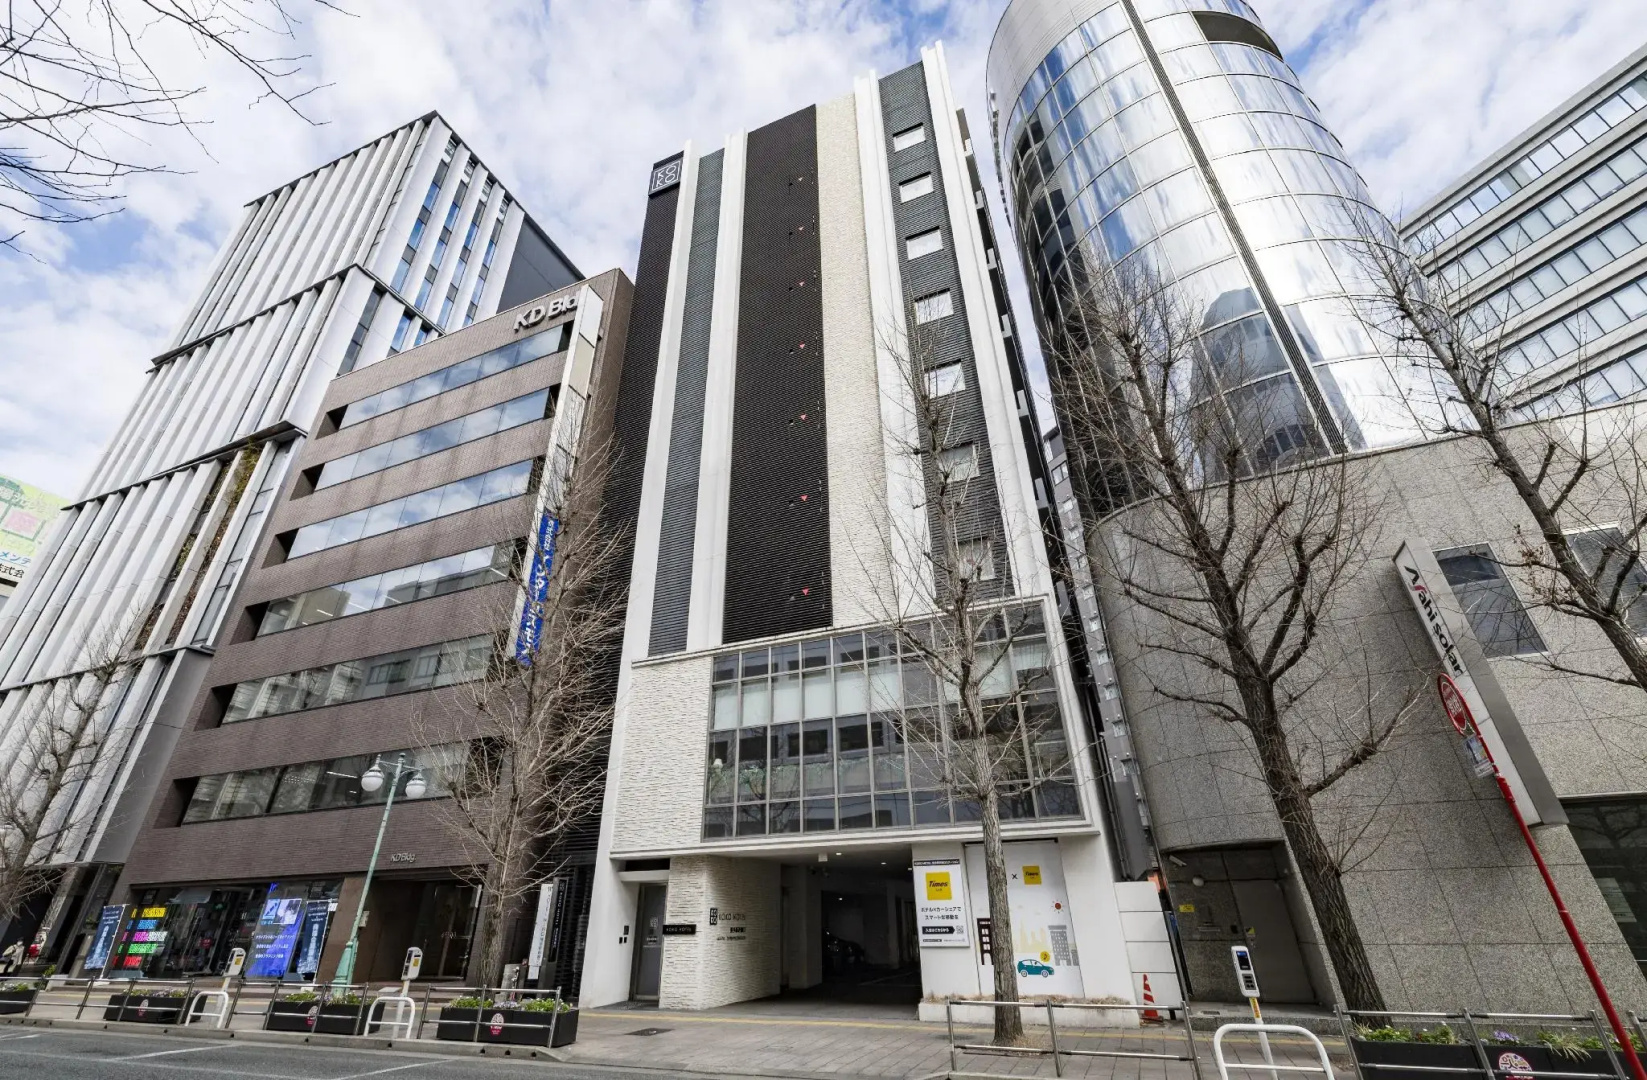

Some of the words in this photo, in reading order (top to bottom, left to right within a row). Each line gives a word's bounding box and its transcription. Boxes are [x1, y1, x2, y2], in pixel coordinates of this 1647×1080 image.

[513, 305, 546, 331] KD
[1404, 565, 1438, 622] Asahi
[1433, 622, 1464, 675] solar
[929, 880, 948, 888] Times
